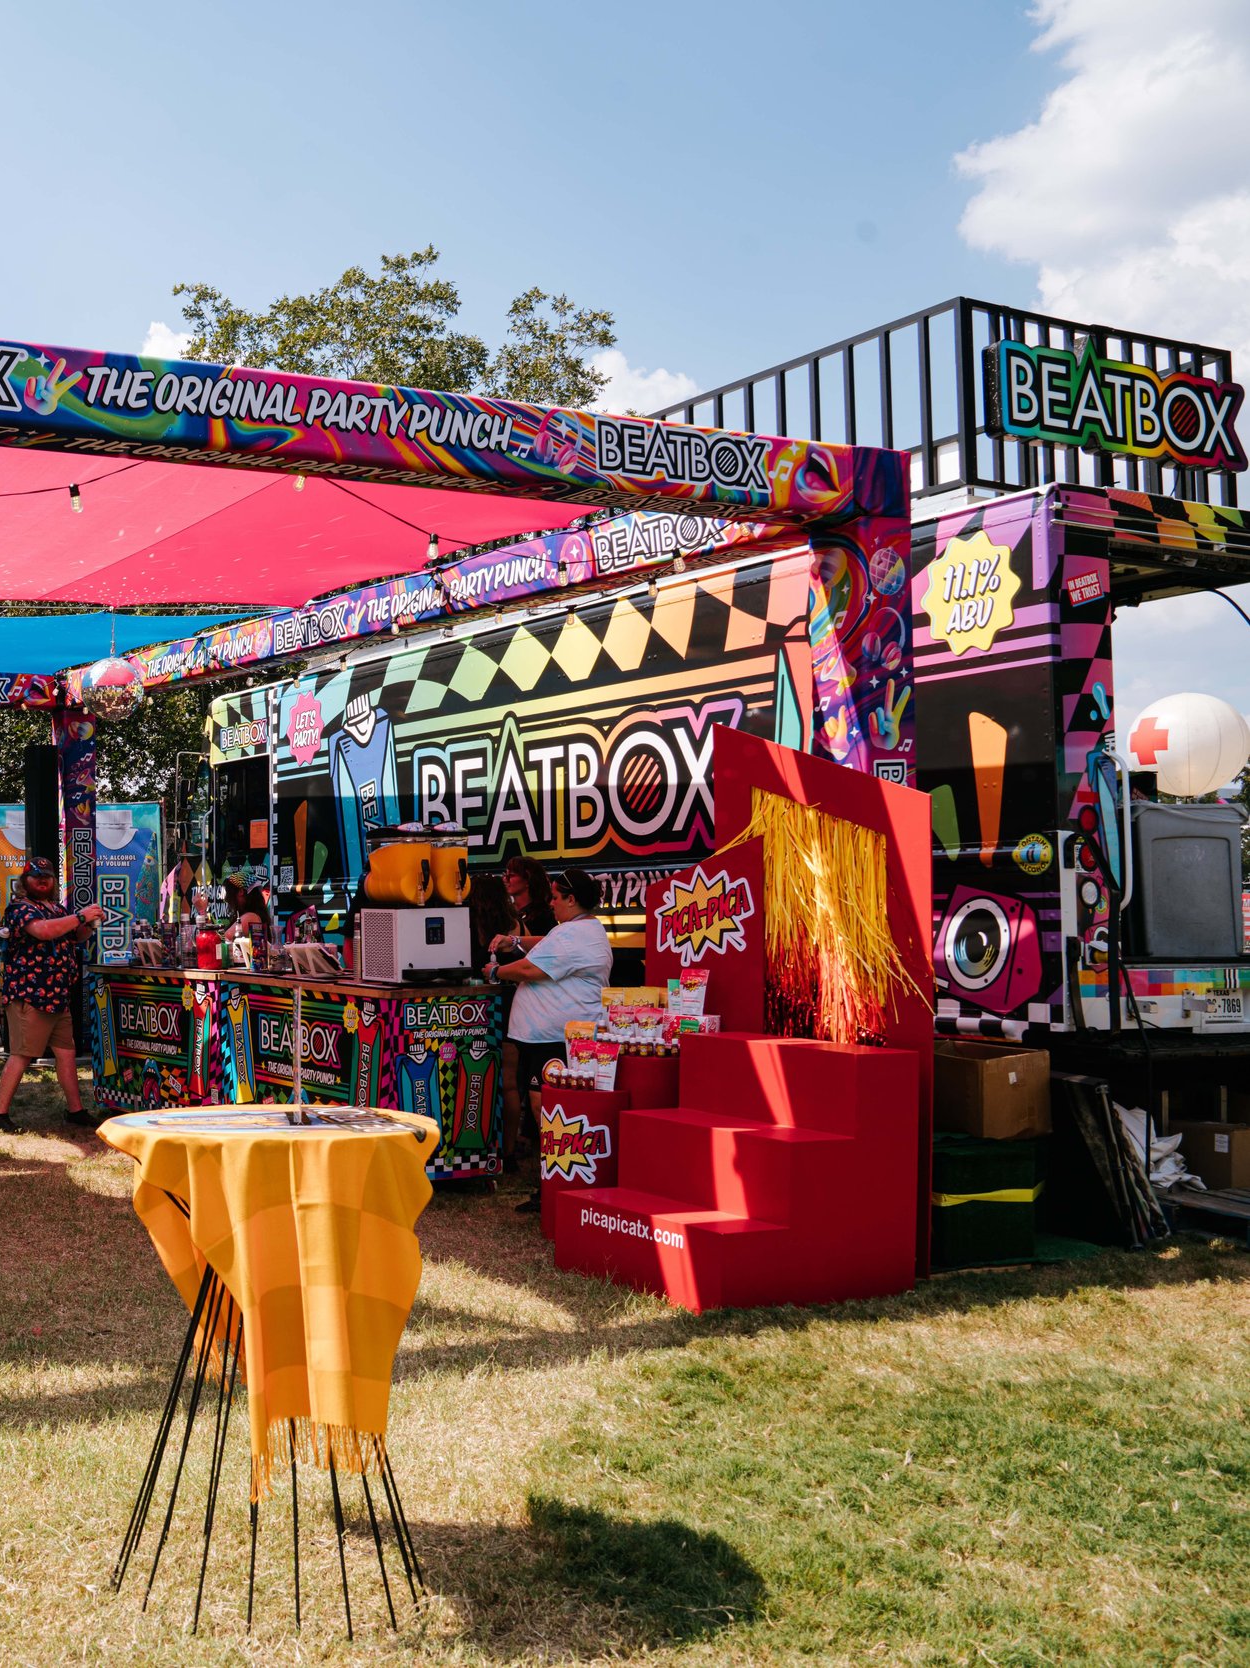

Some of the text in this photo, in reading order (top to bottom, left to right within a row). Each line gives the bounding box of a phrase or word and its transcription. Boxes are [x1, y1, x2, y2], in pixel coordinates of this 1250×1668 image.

[85, 365, 154, 409] THE
[153, 372, 303, 425] ORIGINAL
[306, 388, 413, 437] PARTY
[1007, 346, 1238, 464] BEATBOX
[71, 436, 132, 456] THE
[130, 444, 284, 473] ORIGINAL
[286, 457, 390, 480] PARTY
[597, 420, 772, 492] BEATBOX
[594, 513, 730, 575] BEATBOX
[367, 552, 548, 623] THE ORIGINAL PARTY PUNCH
[942, 554, 1001, 602] 11.1%
[274, 601, 348, 655] BEATBOX
[945, 597, 994, 634] ABV
[146, 659, 162, 679] THE
[222, 635, 253, 661] PUNCH
[222, 722, 266, 750] BEATBOX
[292, 729, 320, 750] PARTY!
[294, 708, 317, 731] LET'S
[420, 715, 716, 847] BEATBOX
[660, 882, 751, 943] PICA-PICA
[119, 1000, 180, 1037] BEATBOX
[406, 1003, 486, 1026] BEATBOX
[413, 1028, 488, 1038] THE ORIGINAL PARTY PUNCH
[267, 1061, 336, 1085] THE PARTY PUNCH
[466, 1074, 483, 1131] BEATBOX
[580, 1207, 685, 1250] picapicatx.com
